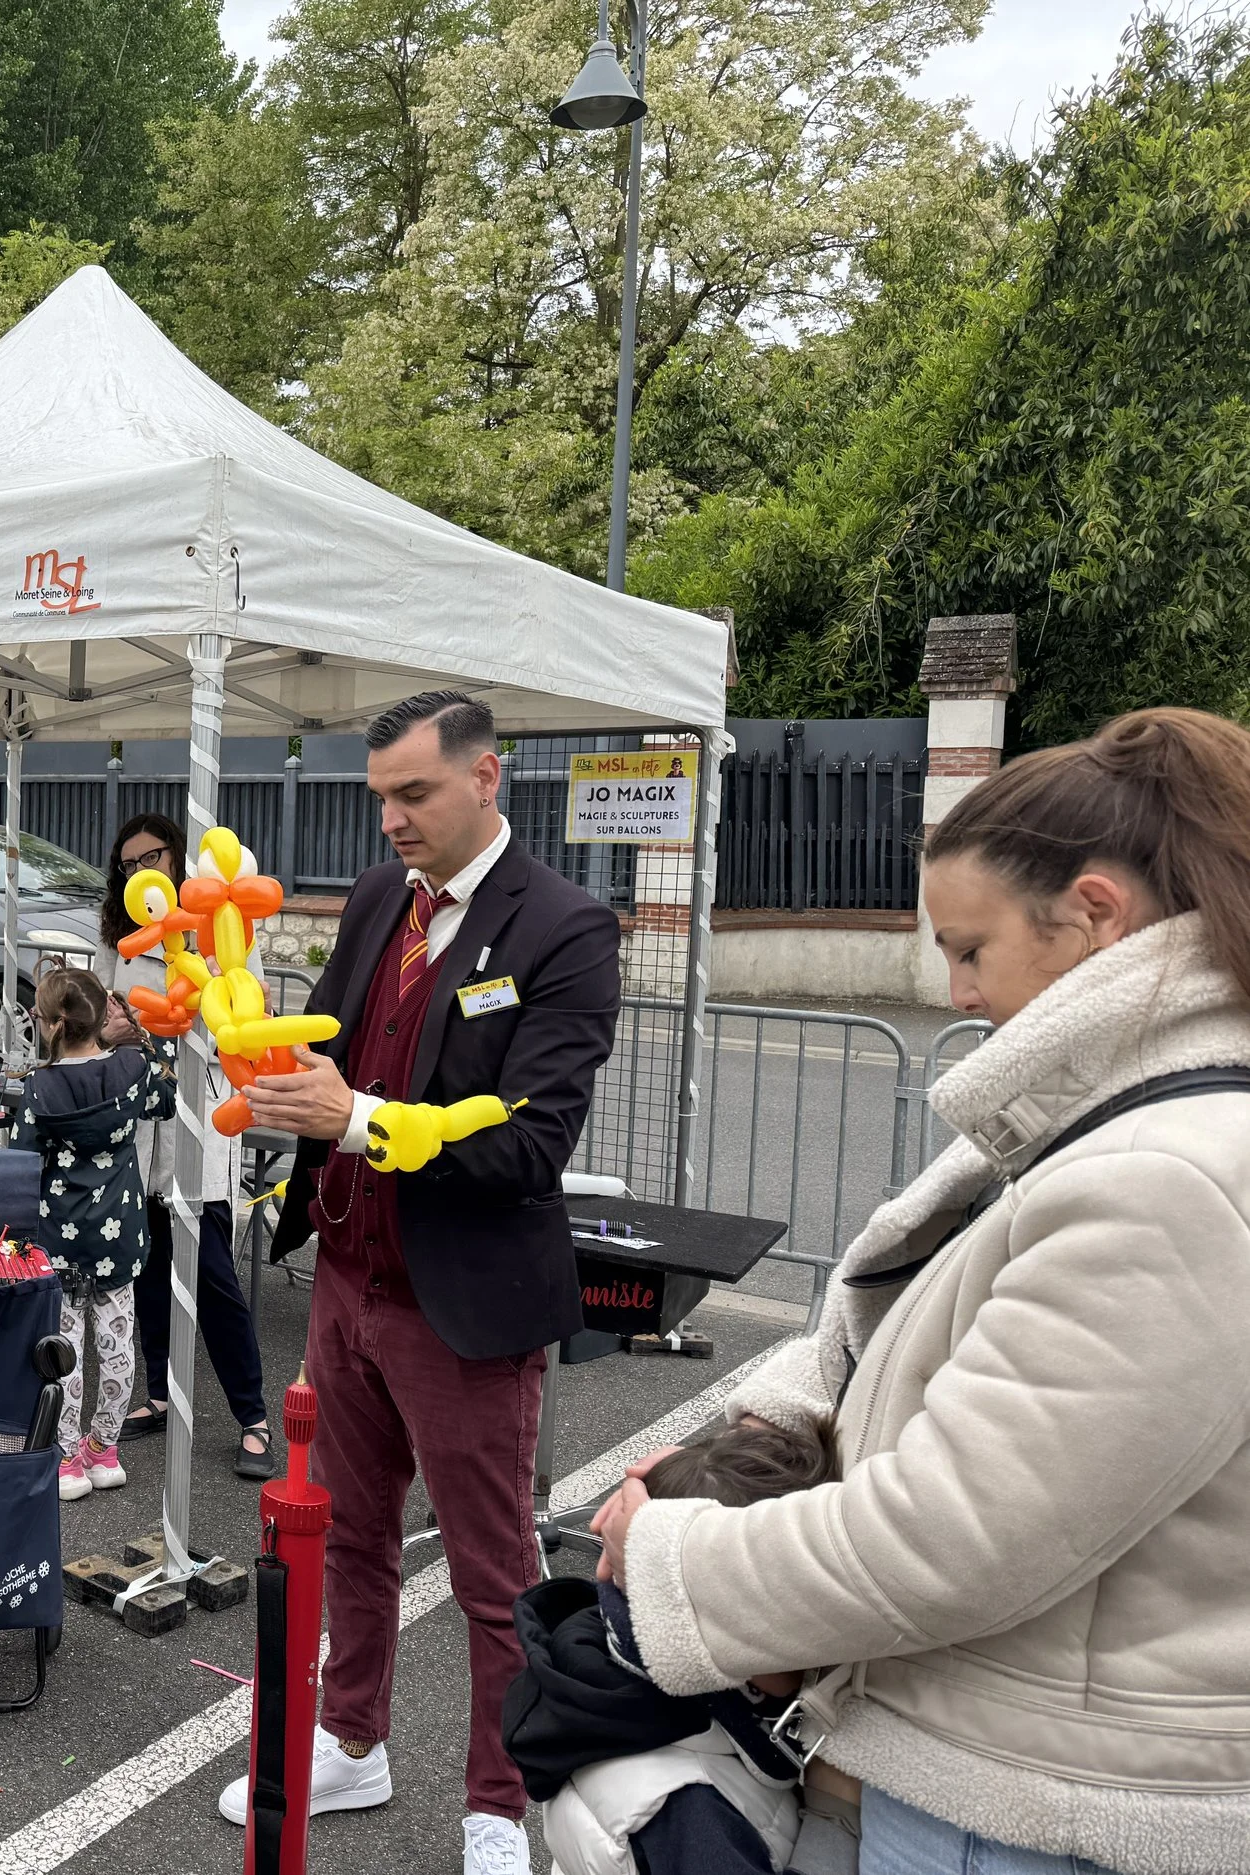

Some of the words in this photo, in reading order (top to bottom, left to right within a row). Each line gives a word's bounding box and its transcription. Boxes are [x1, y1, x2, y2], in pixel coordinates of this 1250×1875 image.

[15, 590, 39, 600] Moret
[40, 588, 62, 599] Seine
[63, 588, 70, 597] &
[71, 586, 94, 600] Loing
[597, 757, 629, 773] MSL
[587, 787, 610, 802] JO
[617, 786, 676, 802] MAGIX
[578, 811, 607, 820] MAGIE
[610, 812, 617, 820] &
[620, 811, 680, 820] SCULPTURES
[596, 826, 615, 835] SUR
[617, 825, 662, 835] BALLONS
[481, 992, 491, 1000] JO
[478, 999, 502, 1010] MAGIX
[0, 1563, 27, 1585] OCHE
